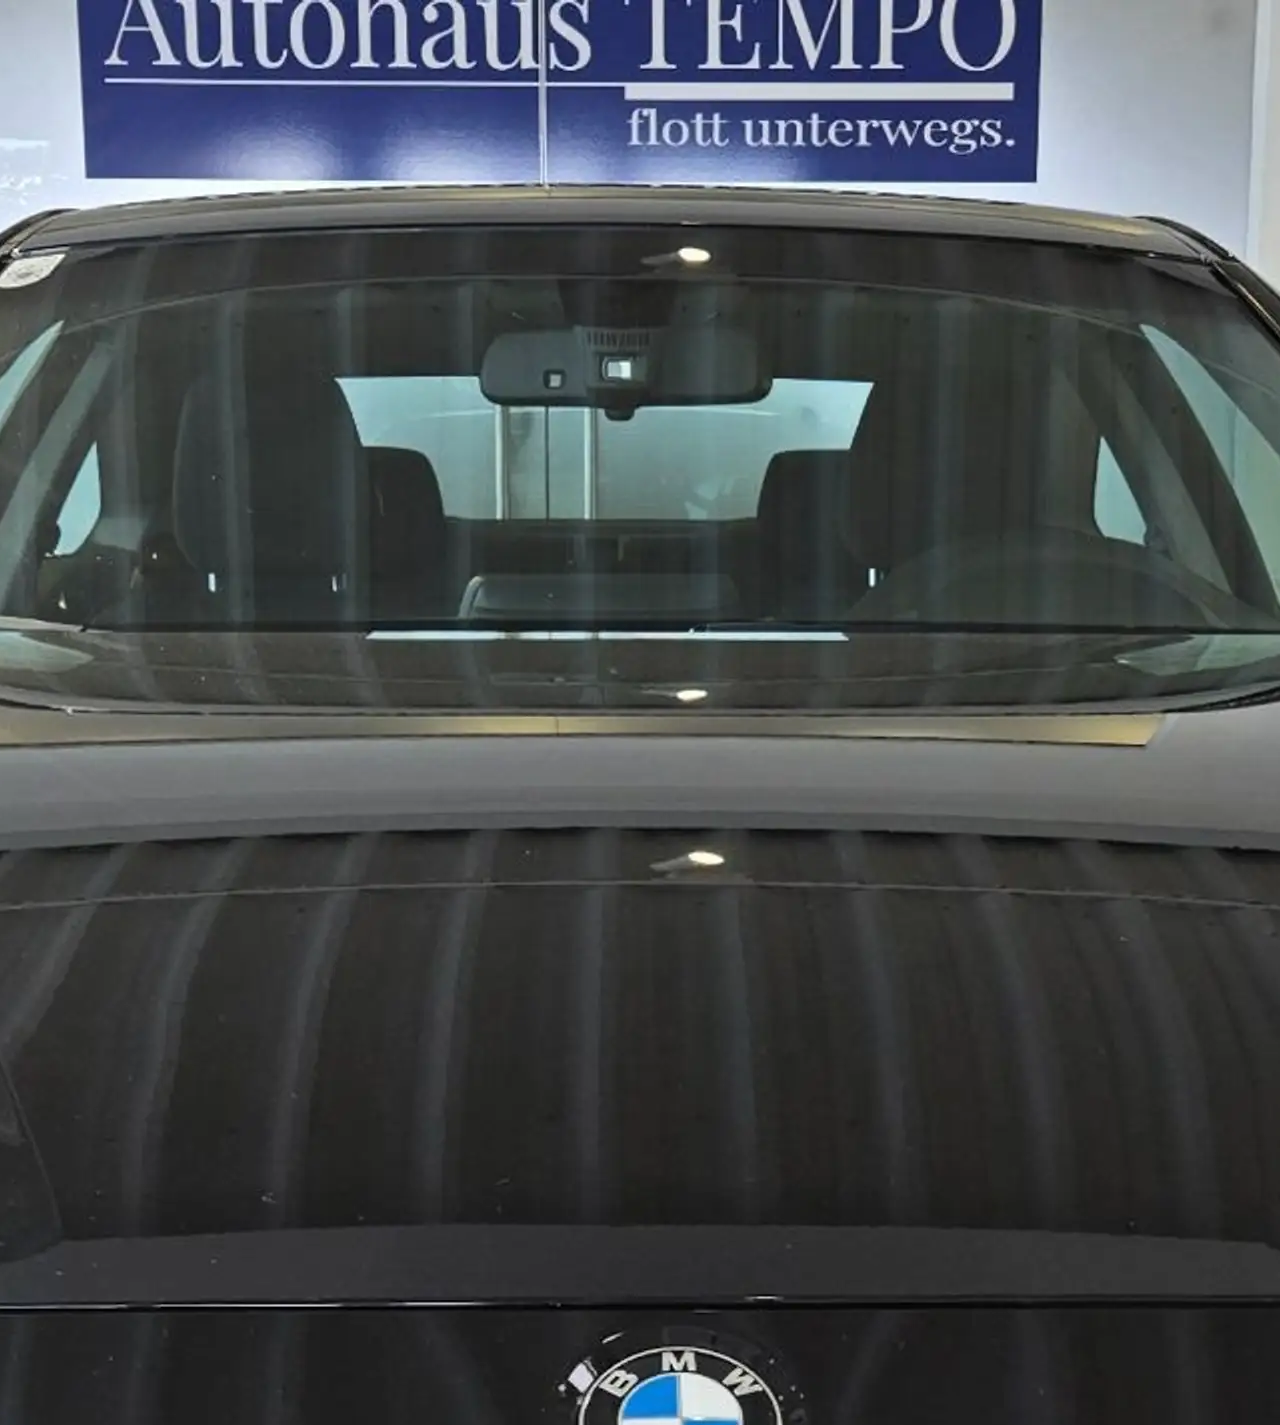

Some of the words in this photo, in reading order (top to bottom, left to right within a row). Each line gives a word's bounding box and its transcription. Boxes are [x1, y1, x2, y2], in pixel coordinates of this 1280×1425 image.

[105, 0, 592, 70] Autohaus
[624, 0, 1016, 71] TEMPO
[628, 108, 729, 148] flott
[742, 113, 1015, 153] unterwegs.
[600, 1351, 764, 1398] BMW
